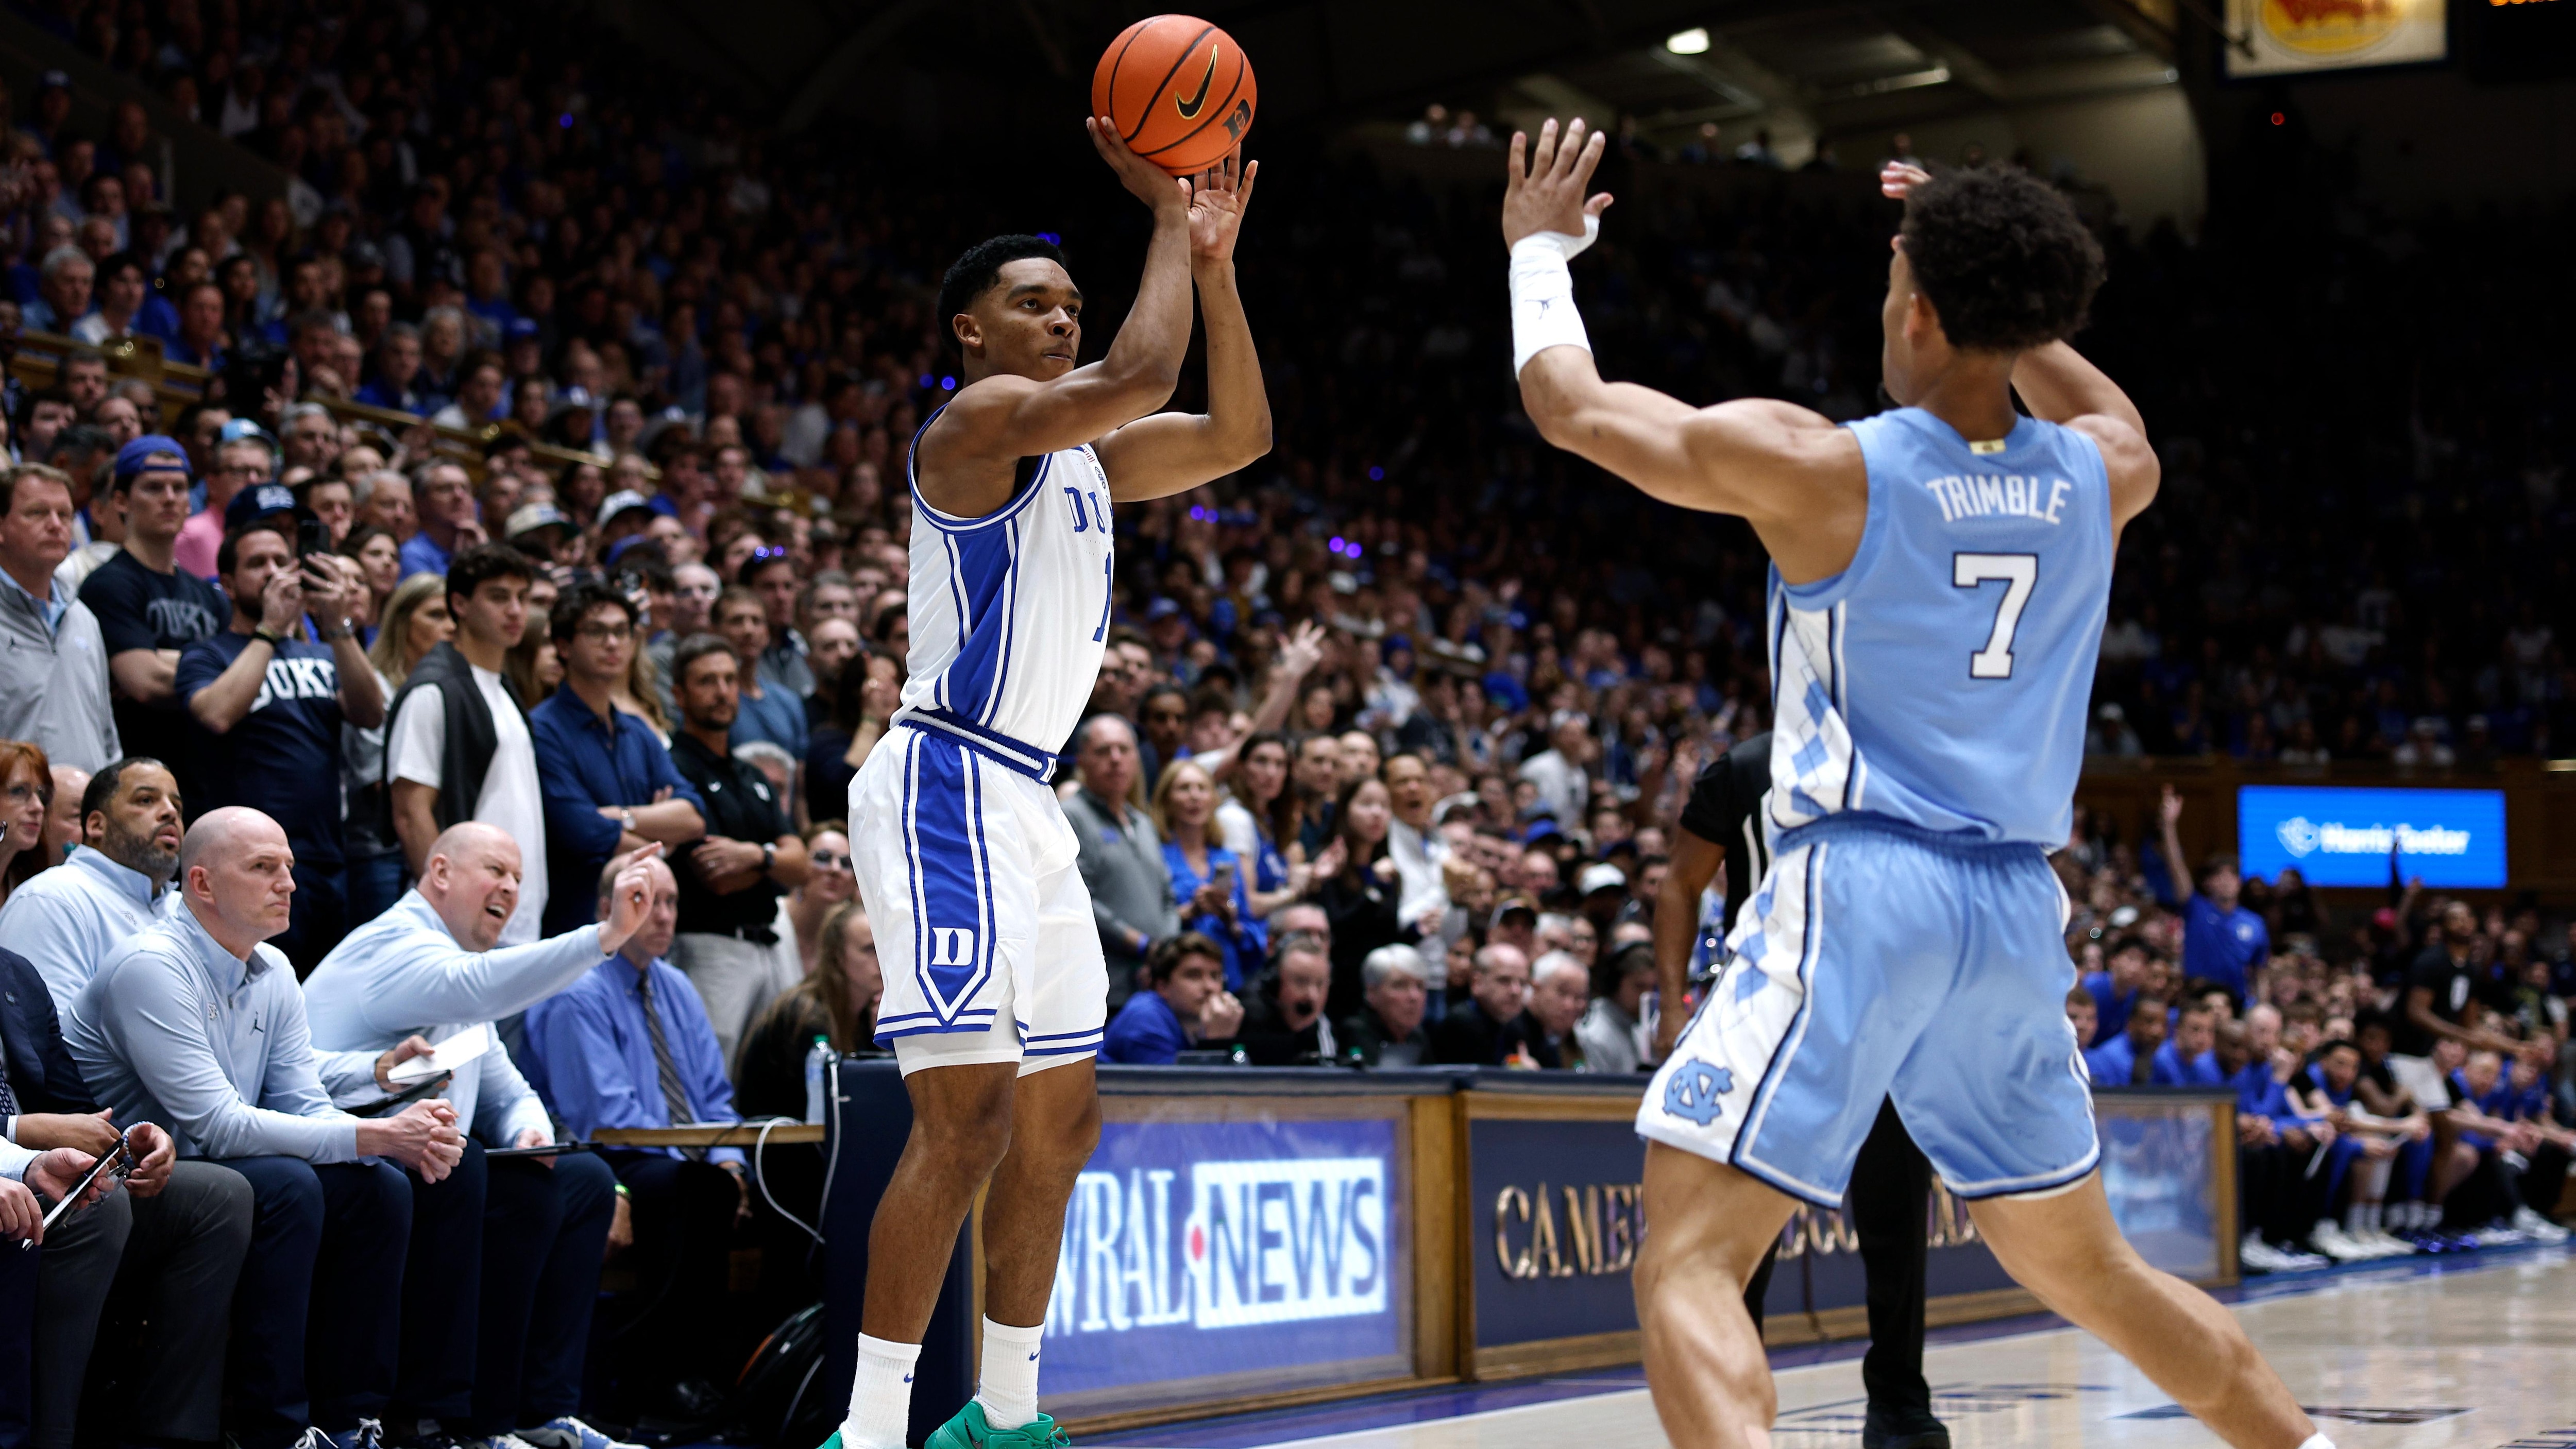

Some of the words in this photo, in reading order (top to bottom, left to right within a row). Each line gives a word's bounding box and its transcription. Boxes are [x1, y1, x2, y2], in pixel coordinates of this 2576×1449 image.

[1064, 487, 1114, 549] DU
[1926, 474, 2072, 525] TRIMBLE
[1952, 552, 2039, 679] 7
[930, 927, 974, 966] D
[1045, 1167, 1190, 1338] WRAL
[1206, 1178, 1379, 1309] NEWS
[1496, 1182, 1648, 1279] CAME
